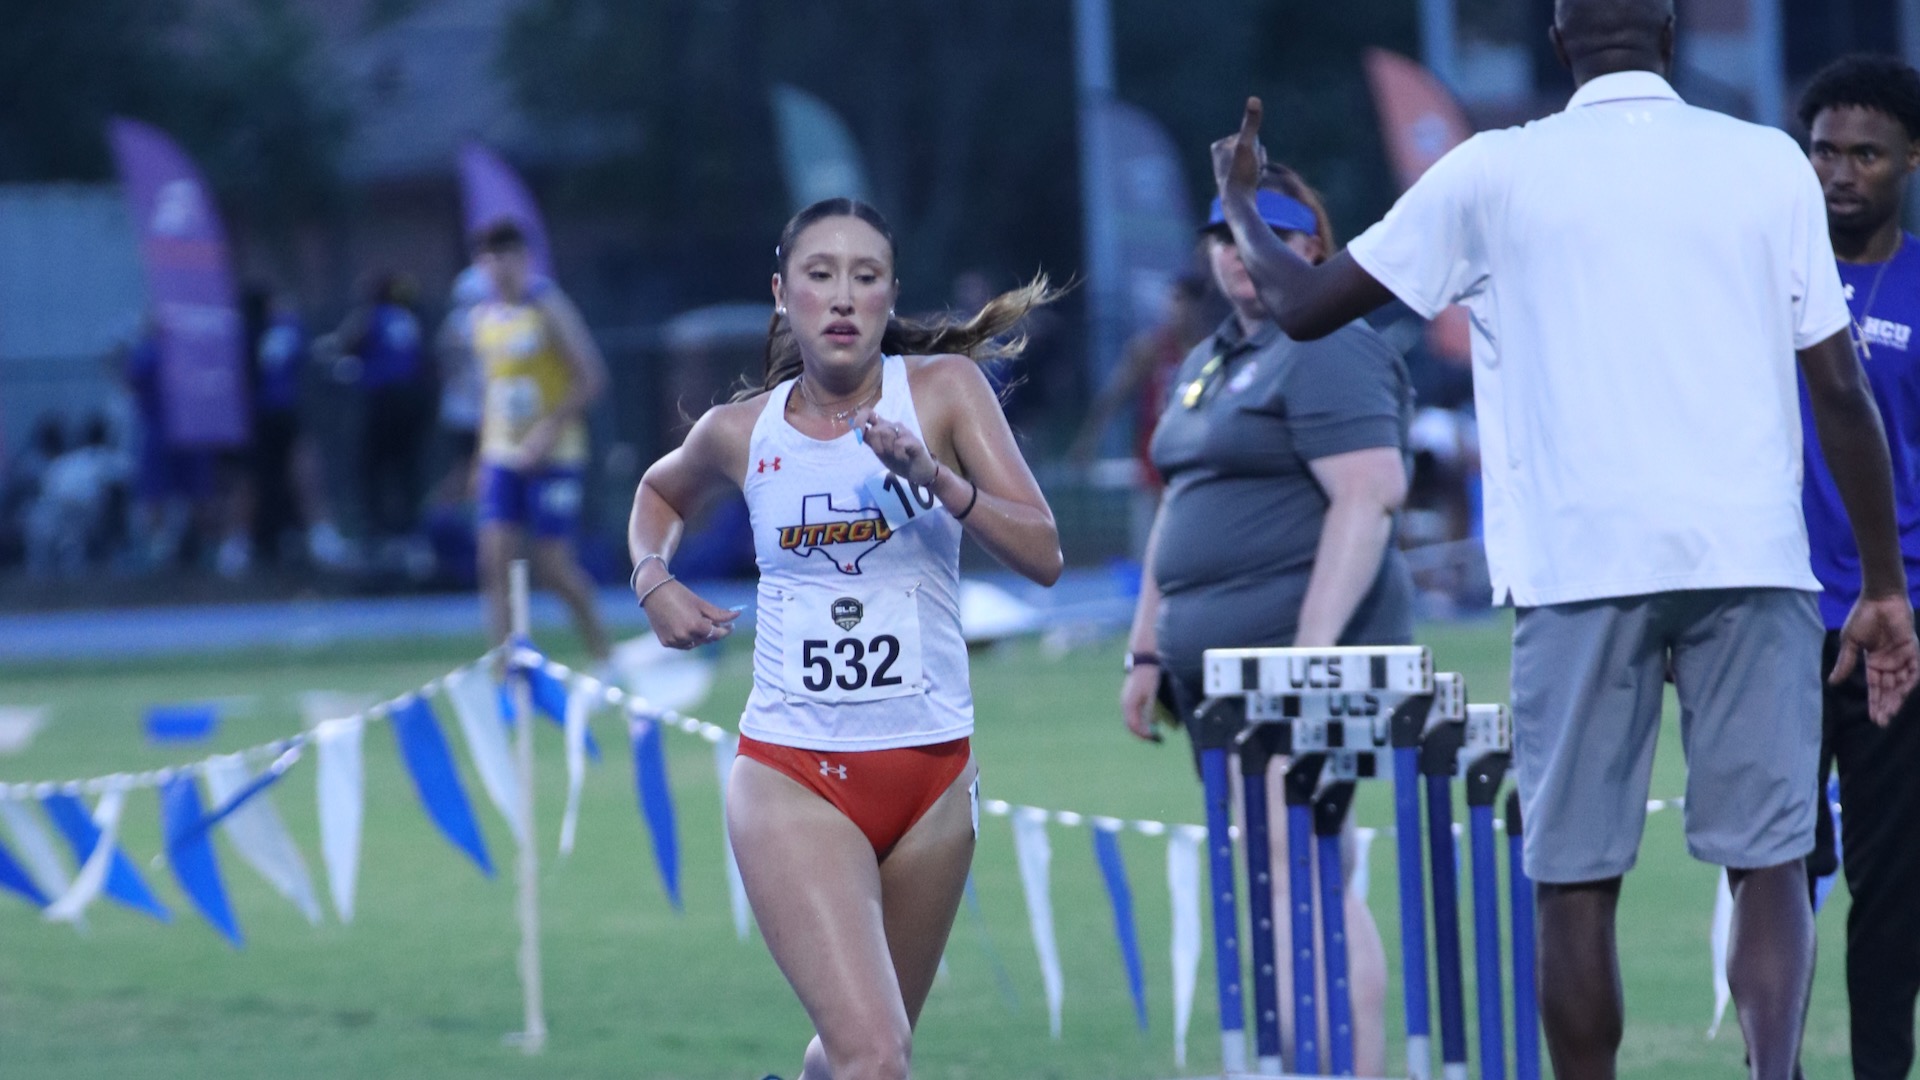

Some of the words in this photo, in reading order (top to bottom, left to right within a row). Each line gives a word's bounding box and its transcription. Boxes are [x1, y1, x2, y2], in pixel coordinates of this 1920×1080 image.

[1863, 315, 1912, 342] HCU
[835, 605, 858, 615] SLC
[802, 634, 902, 692] 532
[1288, 656, 1342, 689] UCS
